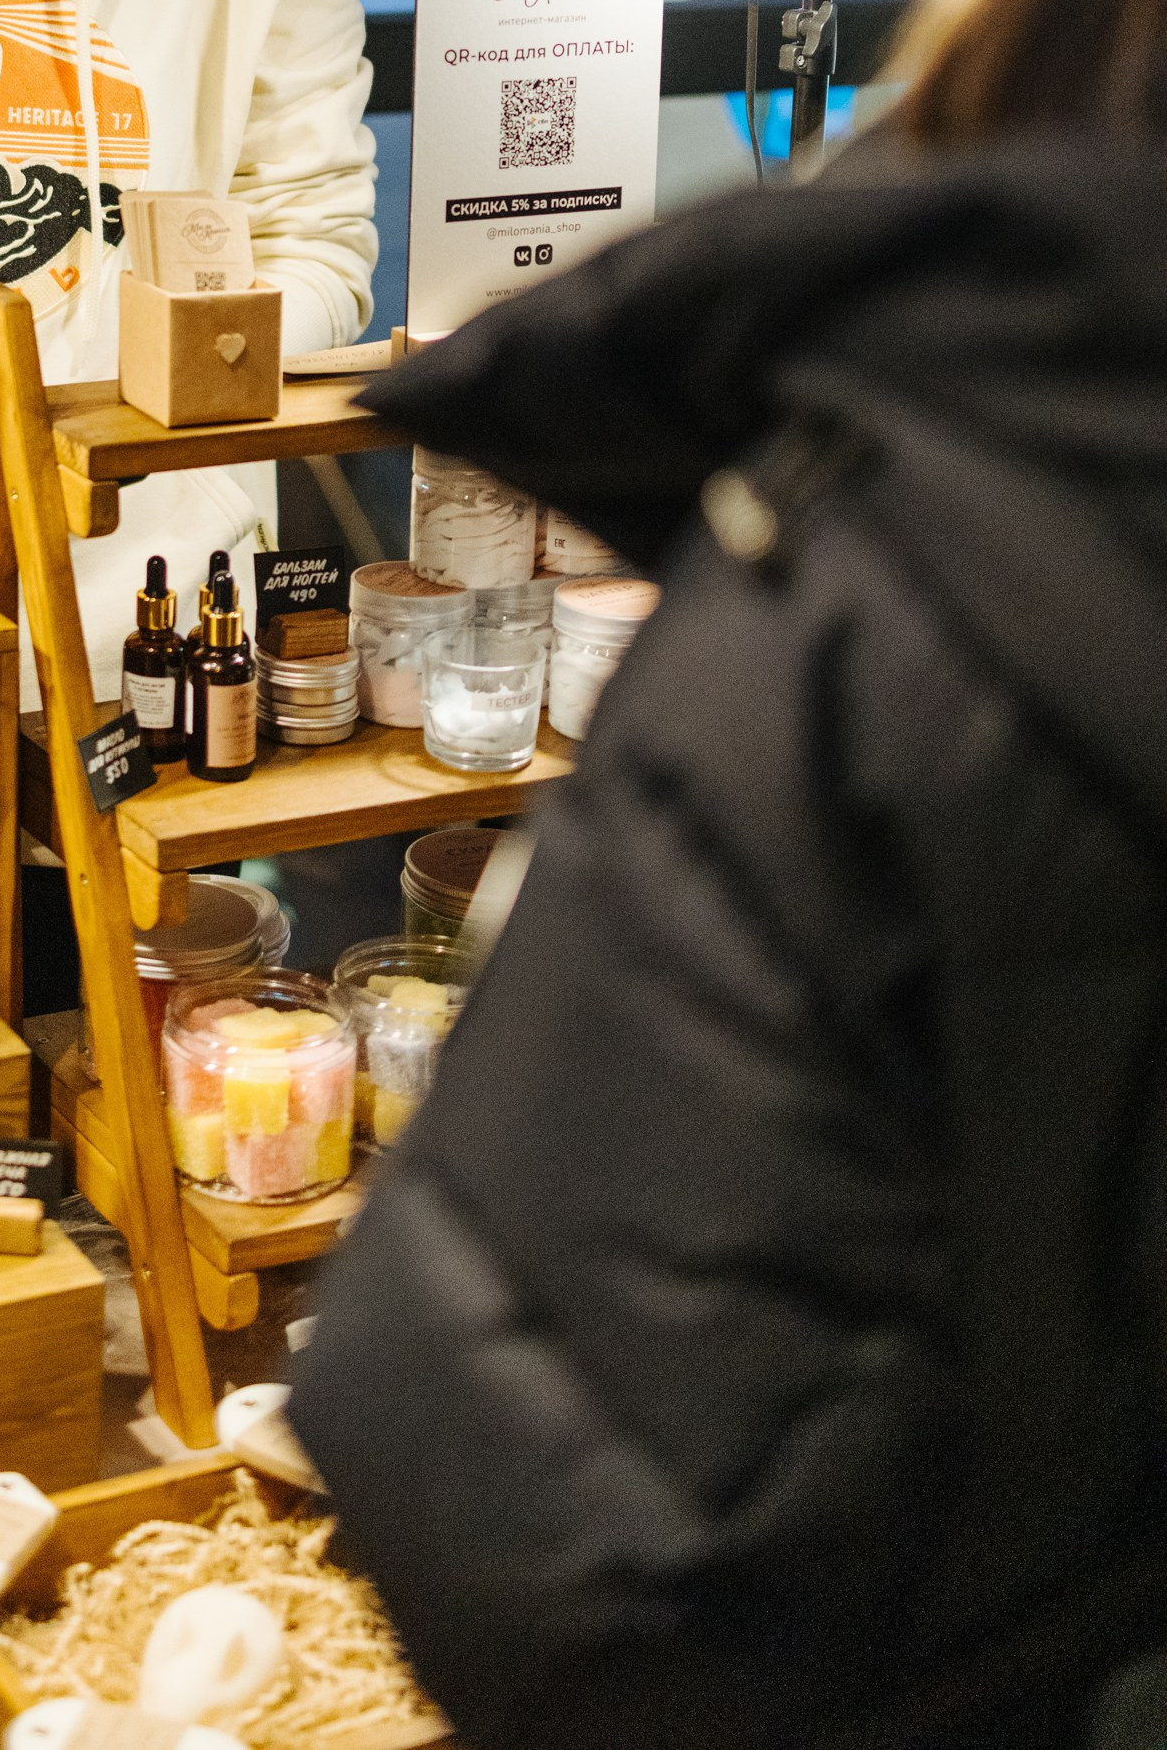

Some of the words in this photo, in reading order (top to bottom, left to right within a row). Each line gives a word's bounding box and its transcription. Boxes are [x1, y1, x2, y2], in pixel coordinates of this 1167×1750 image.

[497, 13, 587, 28] интернет-магазин
[444, 47, 509, 66] QR-код
[514, 45, 547, 62] для
[552, 39, 635, 58] ОПЛАТЫ:
[111, 112, 133, 132] 17
[450, 199, 509, 219] СКИДКА
[511, 197, 531, 213] 5%
[532, 198, 548, 211] за
[550, 191, 618, 211] подписку:
[486, 220, 582, 241] @milomania_shop
[273, 558, 328, 575] БАЛЬЗАМ
[263, 575, 291, 591] ДЛЯ
[291, 568, 339, 586] НОГТЕЙ
[289, 588, 317, 603] 490
[488, 693, 531, 709] ТЕСТЕР
